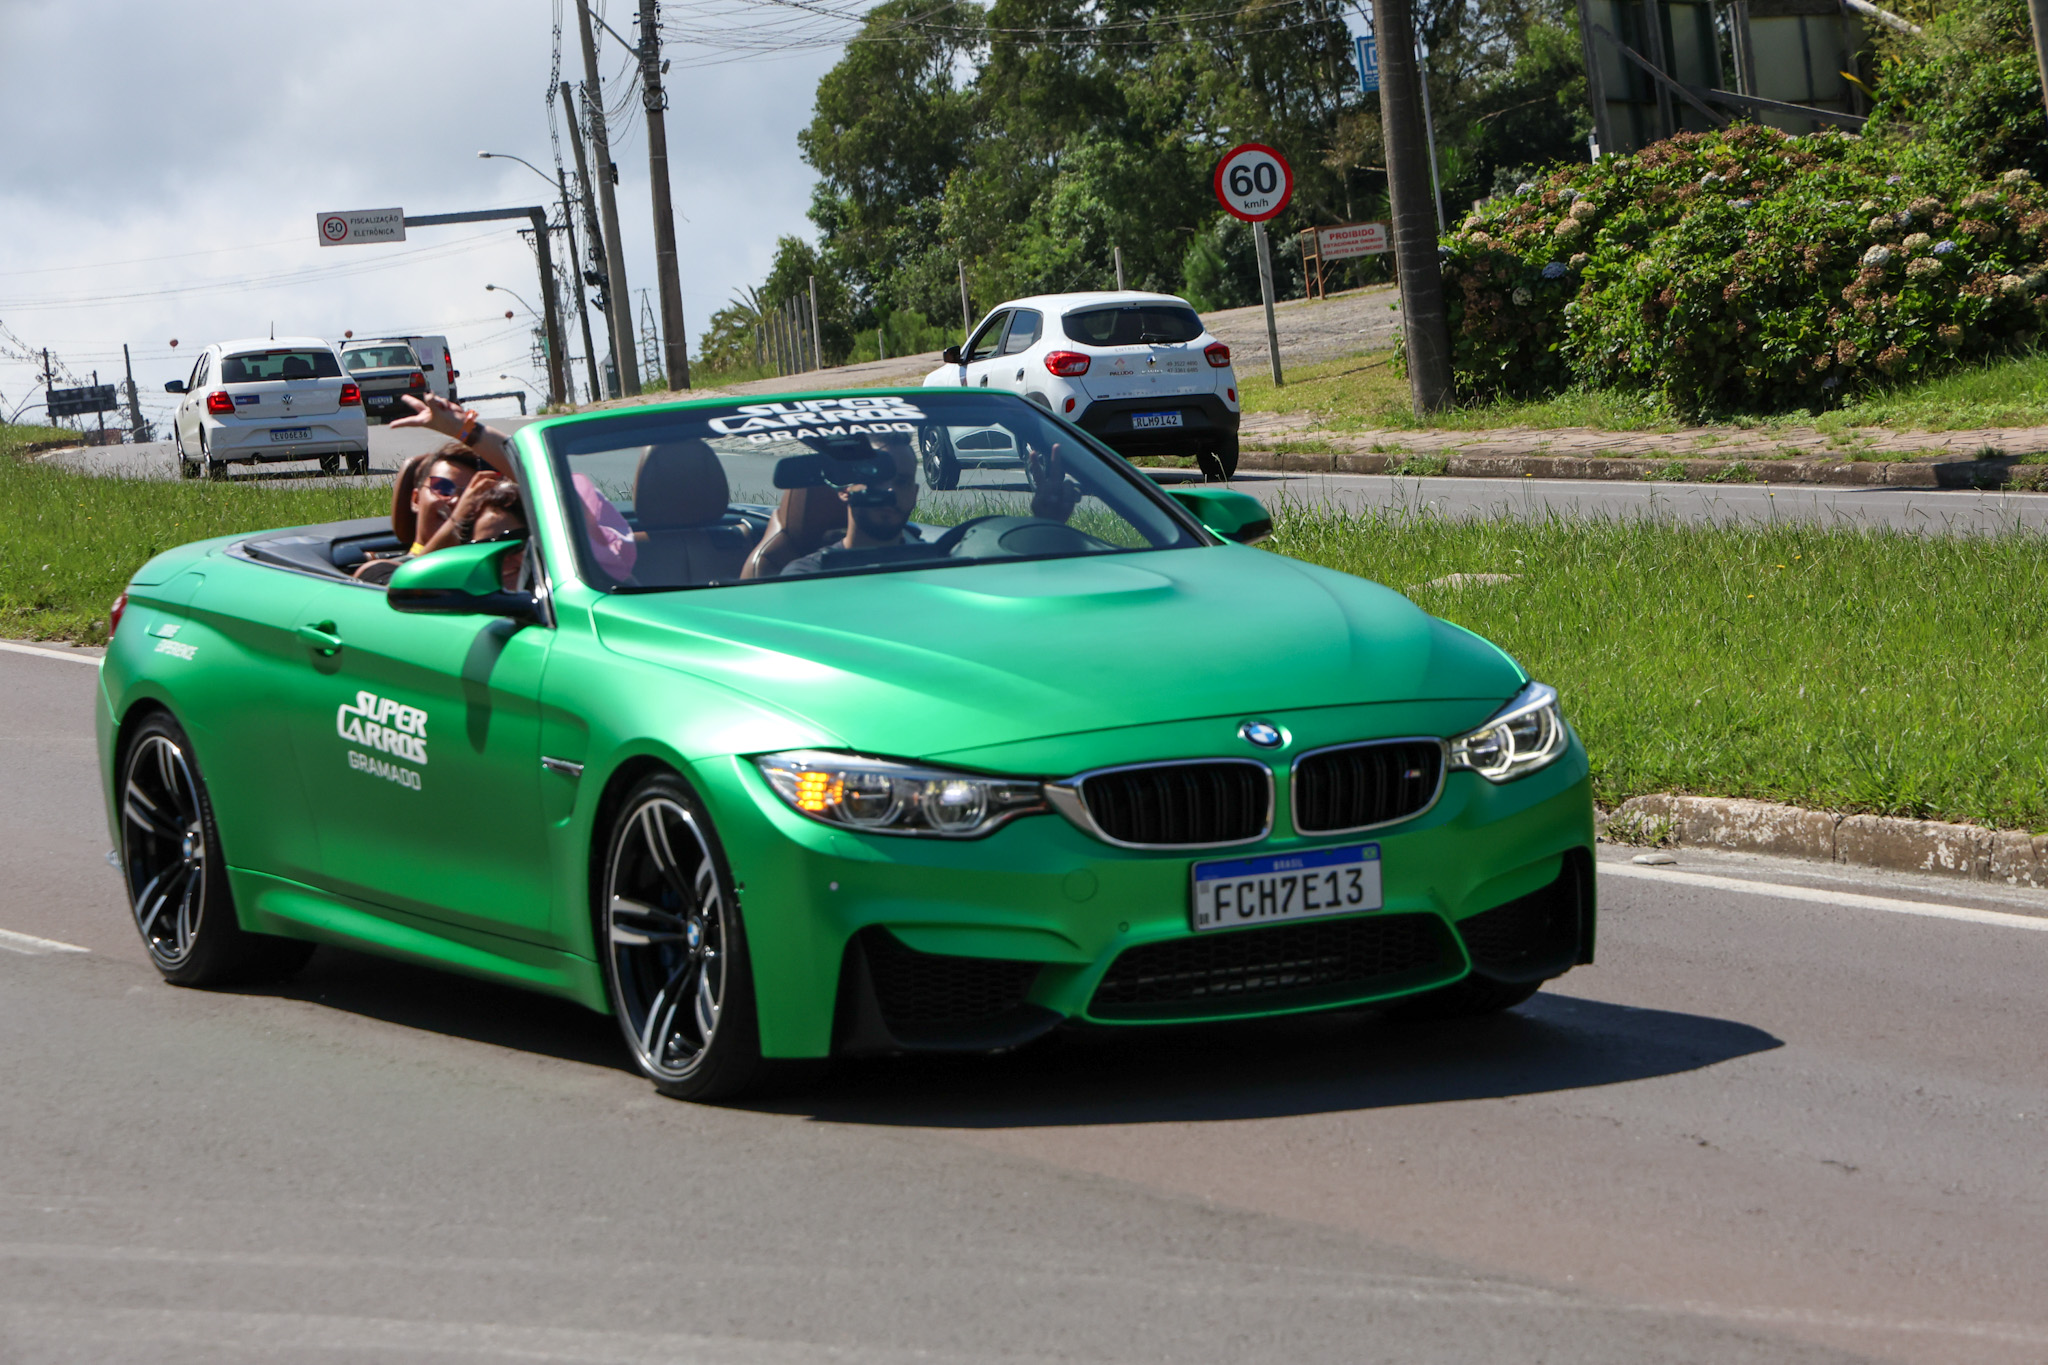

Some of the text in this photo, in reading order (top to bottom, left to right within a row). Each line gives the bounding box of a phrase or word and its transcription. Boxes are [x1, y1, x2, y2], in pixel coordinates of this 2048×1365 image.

[1229, 162, 1277, 197] 60
[1244, 198, 1269, 209] km/h
[327, 222, 343, 233] 50
[350, 214, 399, 225] FISCALIZAÇÃO
[353, 227, 395, 237] ELETRÔNICA
[1329, 228, 1375, 240] PROIBIDO
[737, 396, 920, 416] SUPER
[708, 407, 927, 434] CARROS
[747, 422, 915, 443] GRAMADO
[355, 690, 428, 738] SUPER
[336, 703, 428, 766] CARROS
[347, 750, 422, 791] GRAMADO
[1272, 858, 1304, 870] BRASIL
[1214, 867, 1363, 921] FCH7E13
